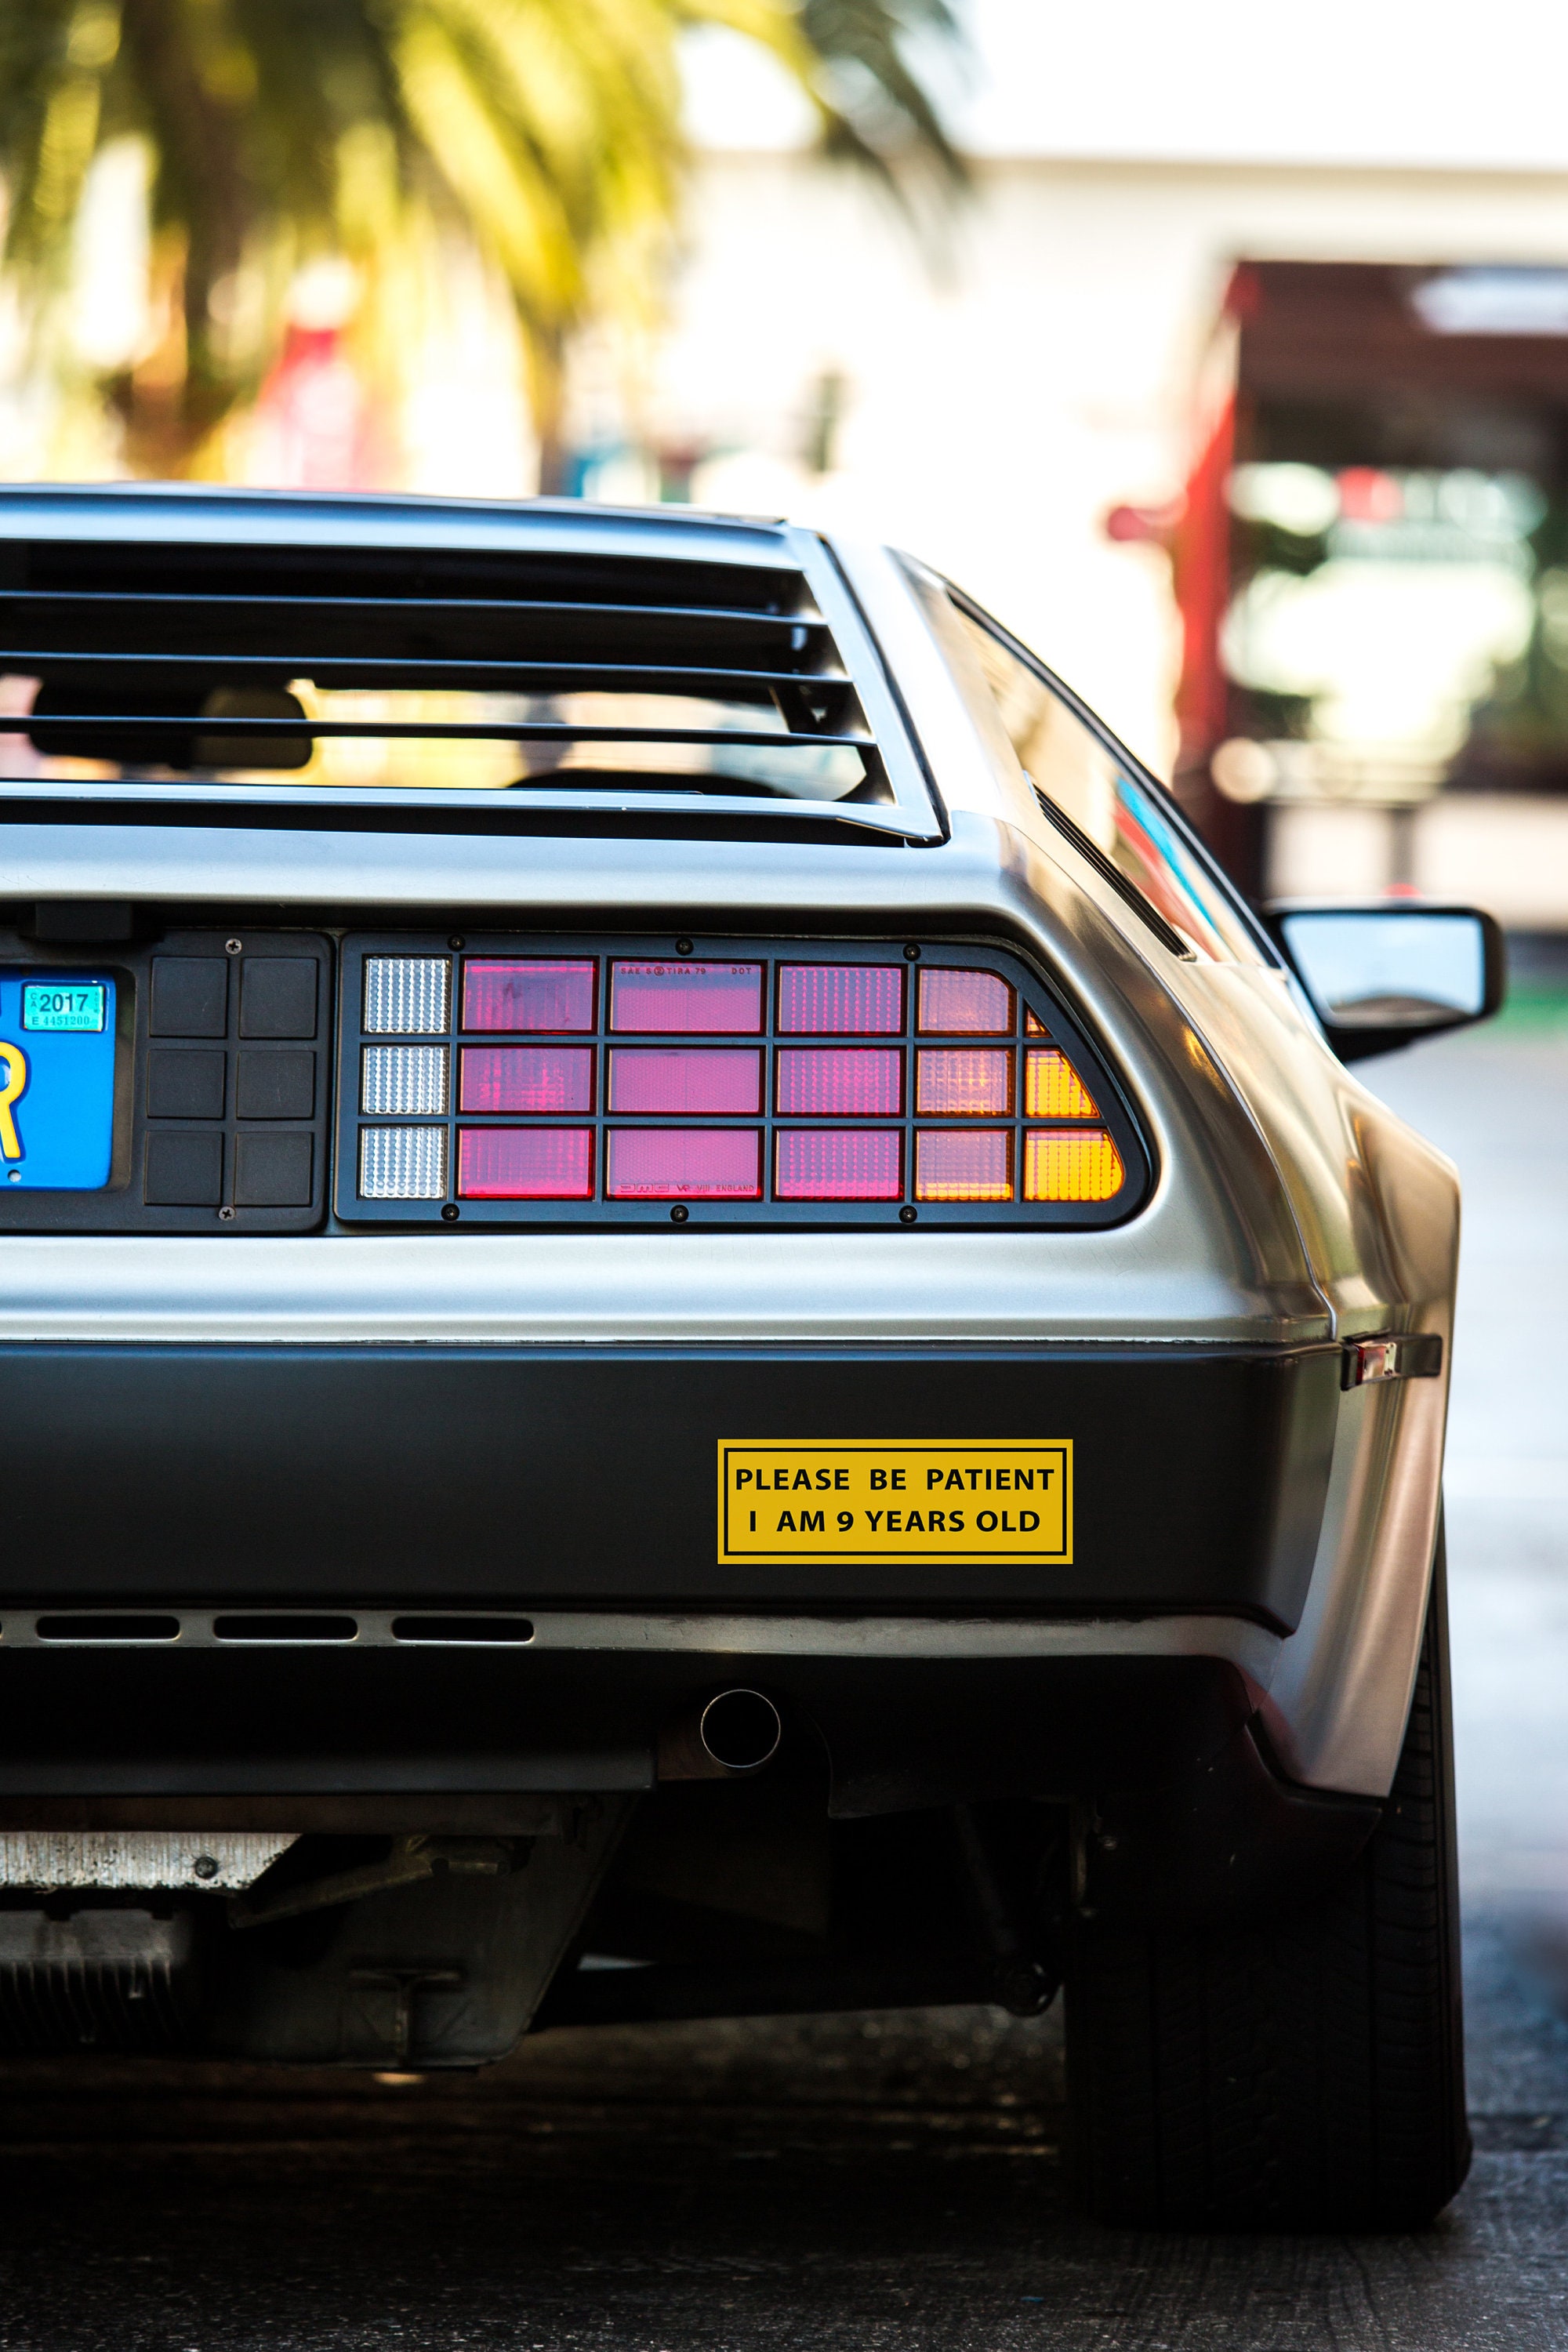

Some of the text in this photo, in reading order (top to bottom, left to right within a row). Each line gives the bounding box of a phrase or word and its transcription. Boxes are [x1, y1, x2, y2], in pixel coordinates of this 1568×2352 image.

[39, 993, 89, 1012] 2017
[31, 1015, 90, 1026] E 4451200
[736, 1468, 1054, 1490] PLEASE BE PATIENT
[750, 1510, 1040, 1533] I AM 9 YEARS OLD
